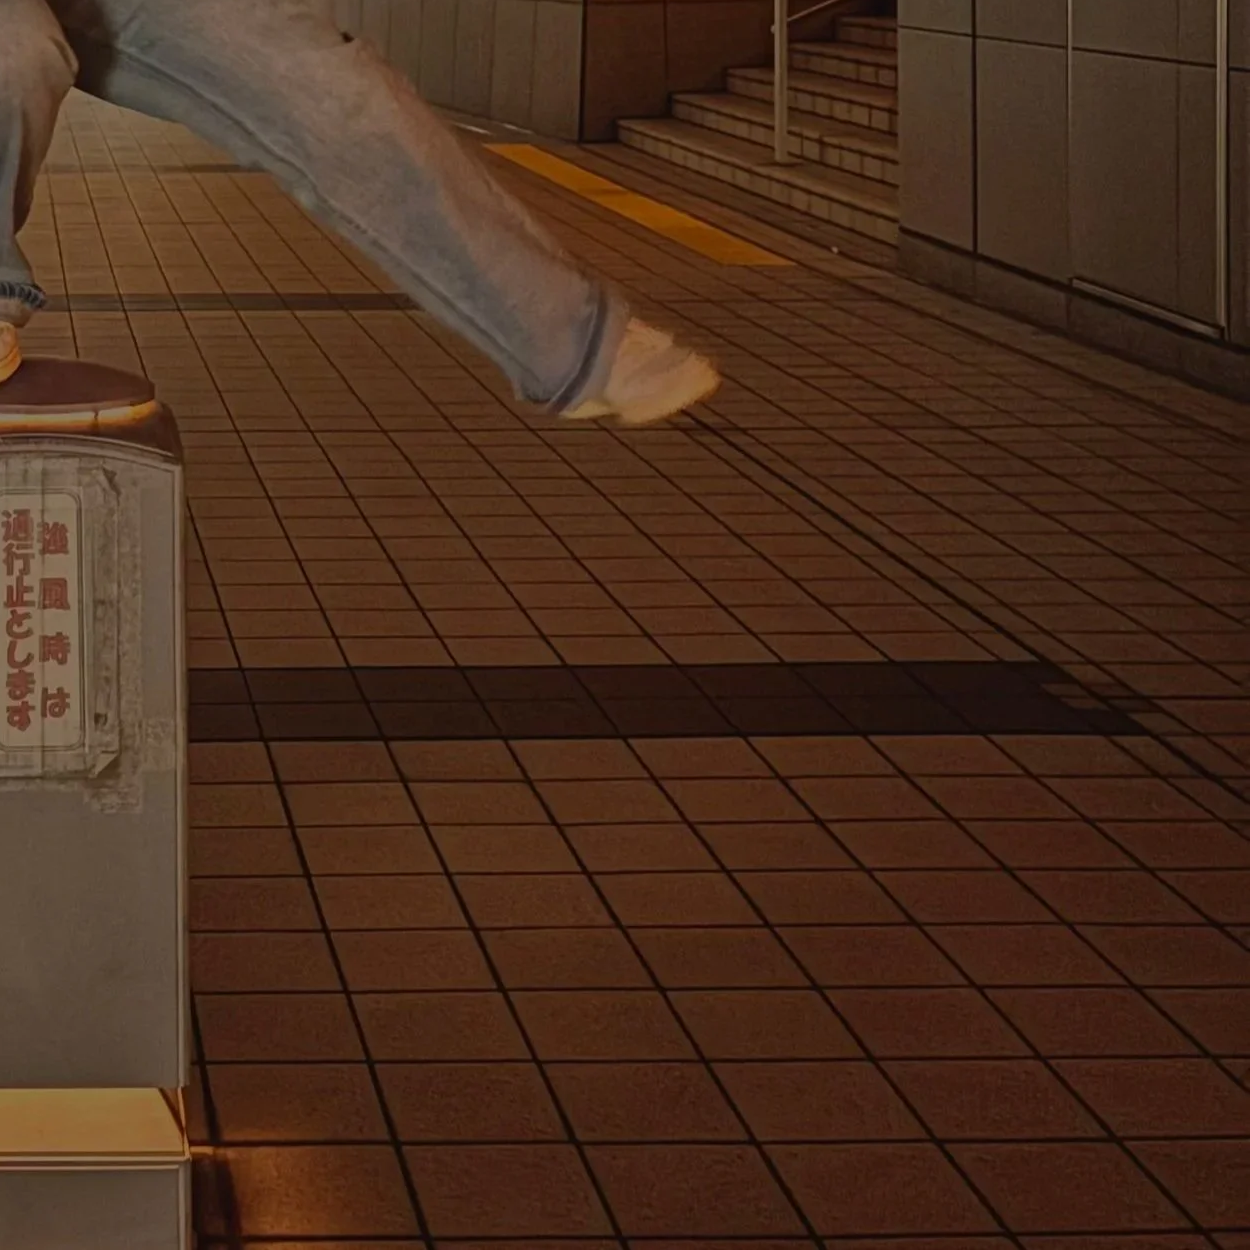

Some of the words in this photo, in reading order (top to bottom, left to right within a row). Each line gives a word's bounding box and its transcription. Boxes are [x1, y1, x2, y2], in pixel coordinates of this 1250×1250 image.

[1, 508, 36, 732] 通行止とします
[37, 521, 71, 719] 強風時は
